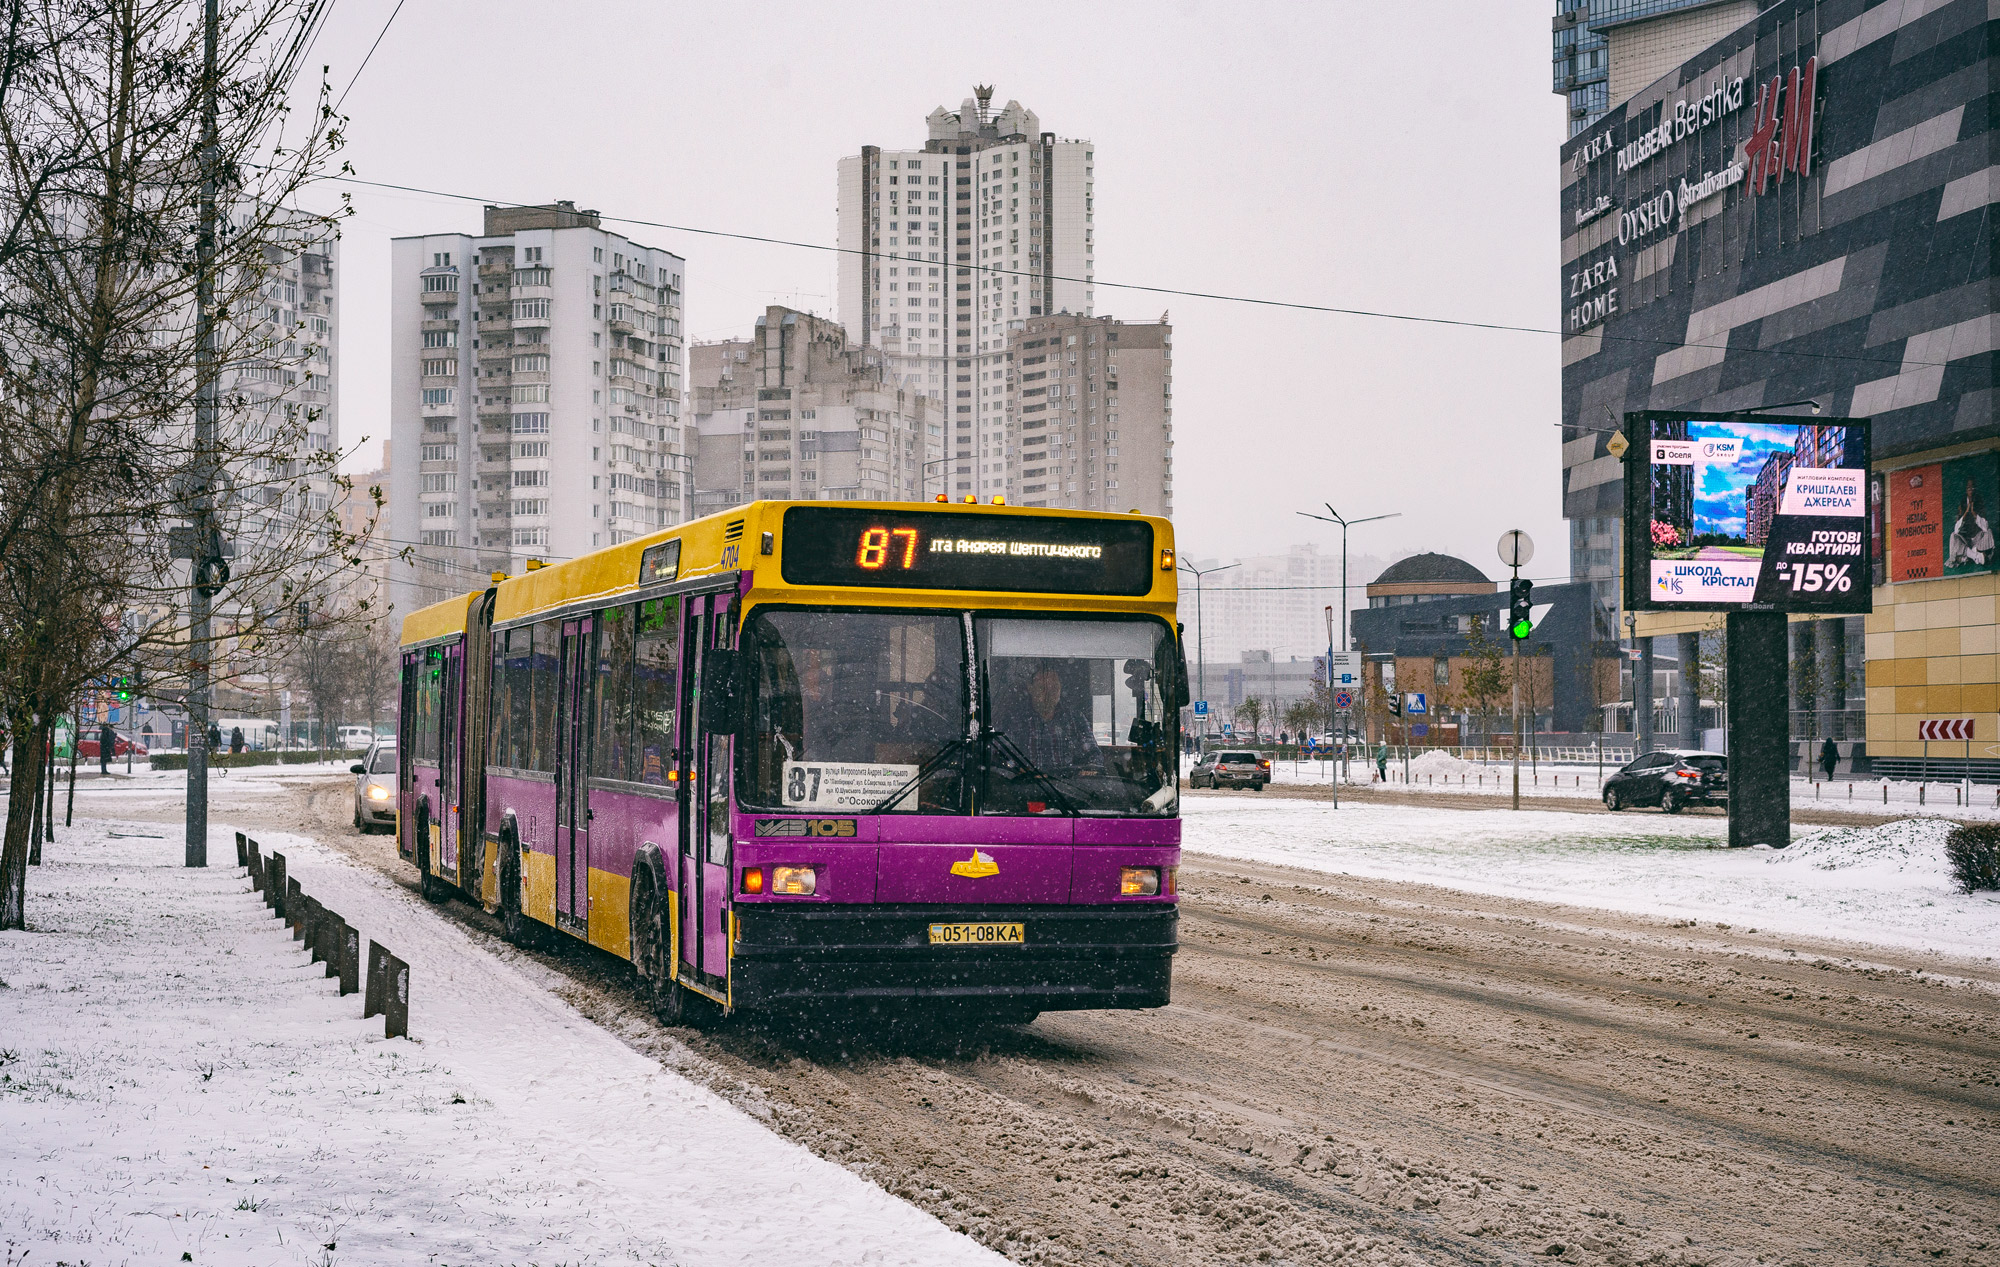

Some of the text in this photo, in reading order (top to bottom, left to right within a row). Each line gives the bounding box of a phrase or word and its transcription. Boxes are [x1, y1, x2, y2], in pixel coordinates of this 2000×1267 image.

[1675, 75, 1743, 142] Bershka
[1744, 56, 1818, 197] H&M
[1572, 130, 1614, 172] ZARA
[1617, 120, 1673, 175] PULL&BEAR
[1618, 190, 1675, 246] OYSHO
[1571, 255, 1618, 298] ZARA
[1571, 287, 1618, 331] HOME
[1796, 484, 1857, 496] КРИШТАЛЕВІ
[859, 527, 919, 569] 87
[956, 539, 1007, 555] Андрея
[1010, 541, 1102, 559] Шептицького
[1786, 542, 1862, 556] КВАРТИРИ
[1811, 530, 1862, 543] ГОТОВІ
[720, 543, 740, 569] 4704
[1674, 565, 1723, 576] ШКОЛА
[1702, 576, 1754, 587] КРІСТАЛ
[1779, 563, 1852, 592] -15%
[1741, 602, 1776, 611] BigBoard
[788, 766, 822, 802] 87
